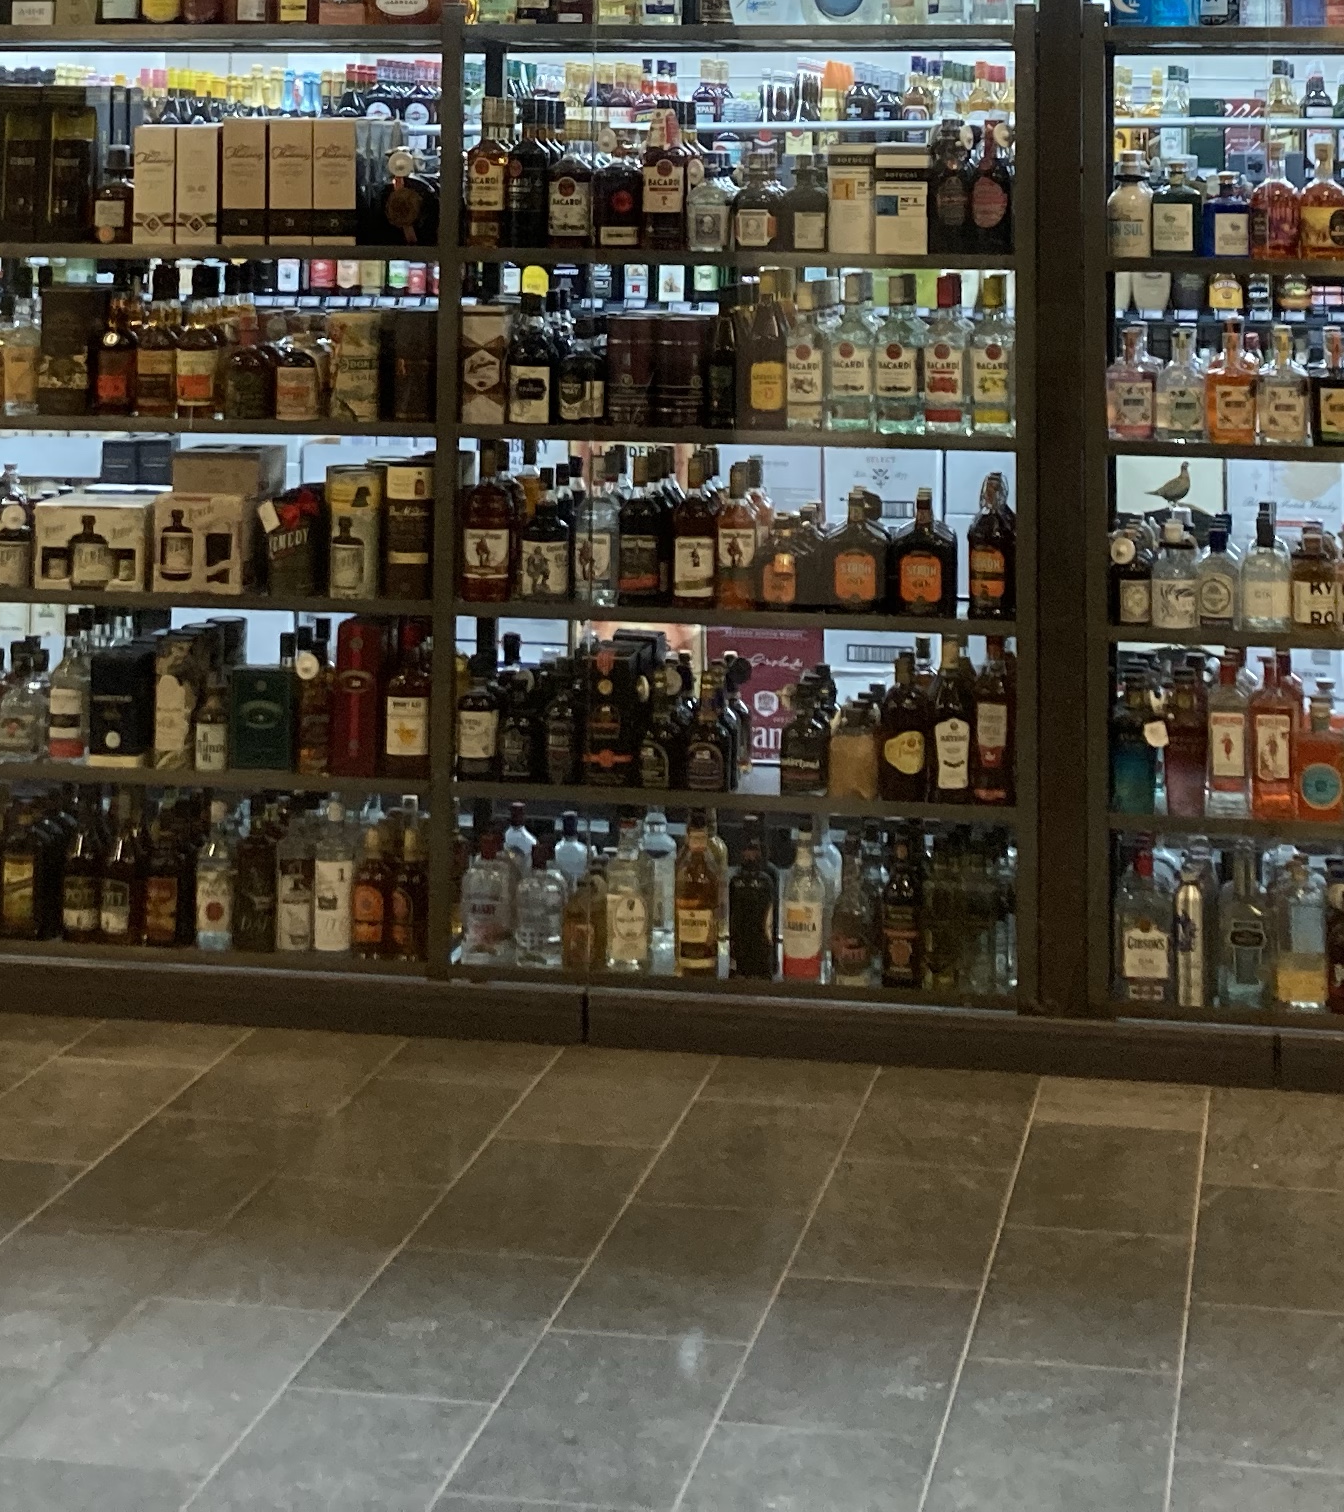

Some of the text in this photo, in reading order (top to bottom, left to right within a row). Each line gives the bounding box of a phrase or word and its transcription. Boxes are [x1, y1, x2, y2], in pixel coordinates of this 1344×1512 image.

[1123, 224, 1144, 236] SUL
[1310, 581, 1333, 596] KY
[1311, 611, 1333, 625] RO
[1127, 937, 1166, 951] GIBSON'S
